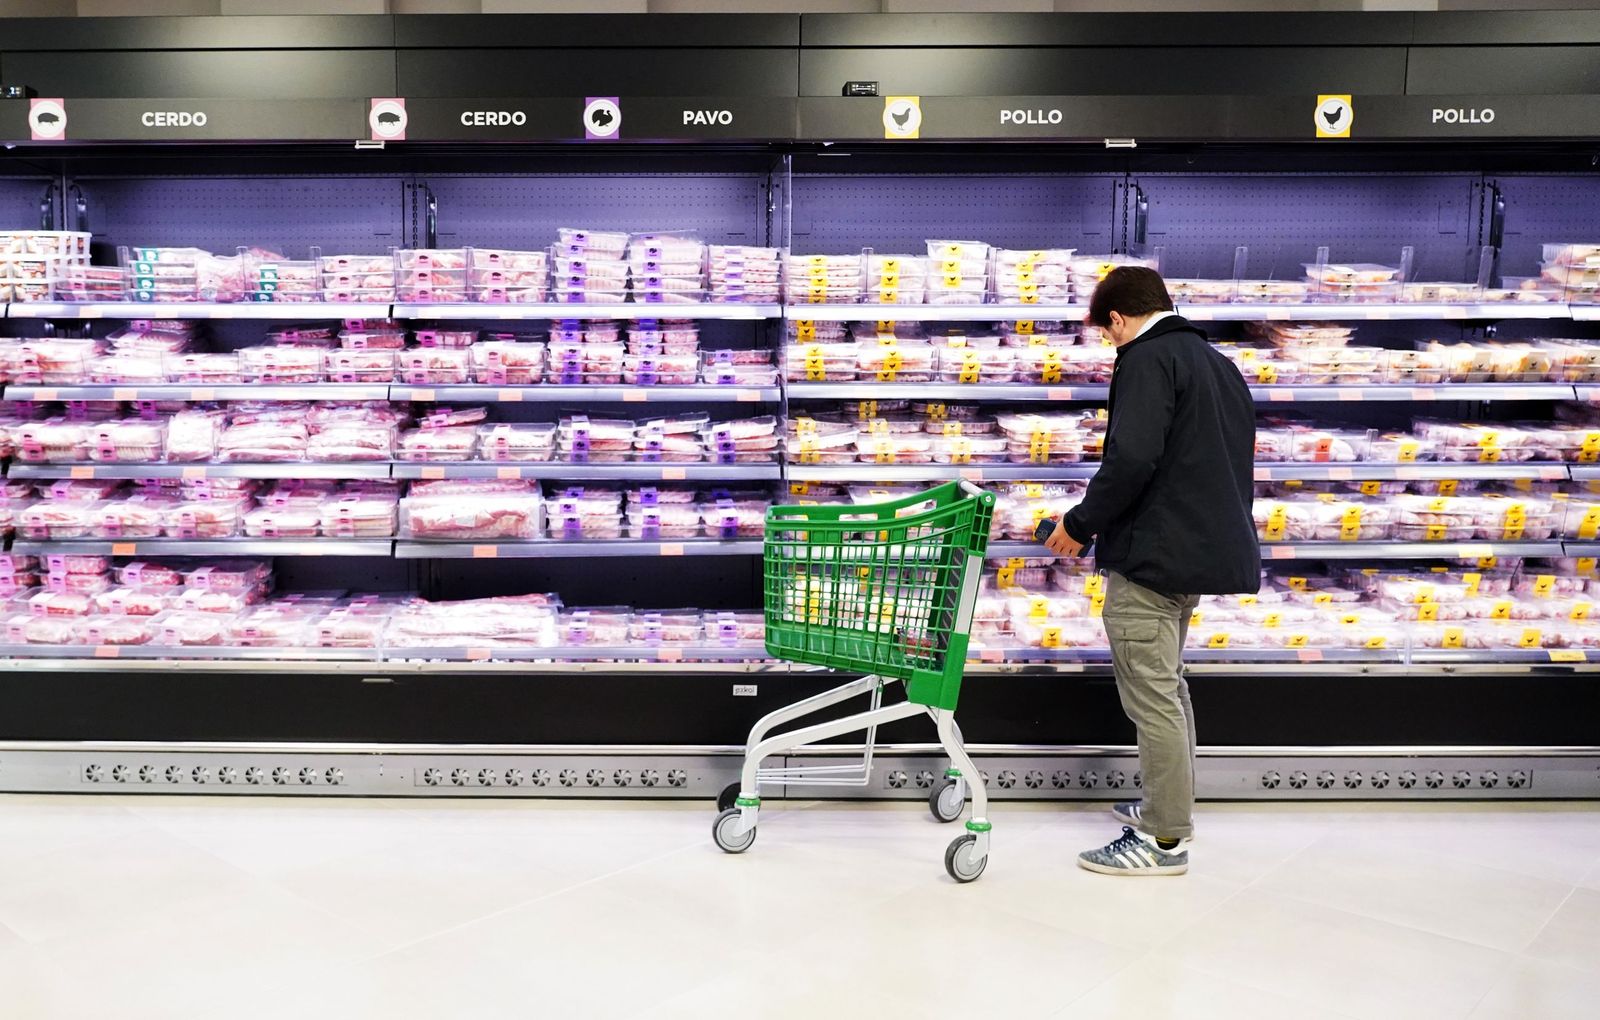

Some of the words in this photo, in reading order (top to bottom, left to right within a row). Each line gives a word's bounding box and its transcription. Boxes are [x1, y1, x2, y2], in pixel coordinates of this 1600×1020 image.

[142, 112, 207, 127] CERDO
[461, 111, 527, 126] CERDO
[683, 111, 733, 125] PAVO
[1000, 109, 1063, 125] POLLO
[1433, 108, 1495, 124] POLLO
